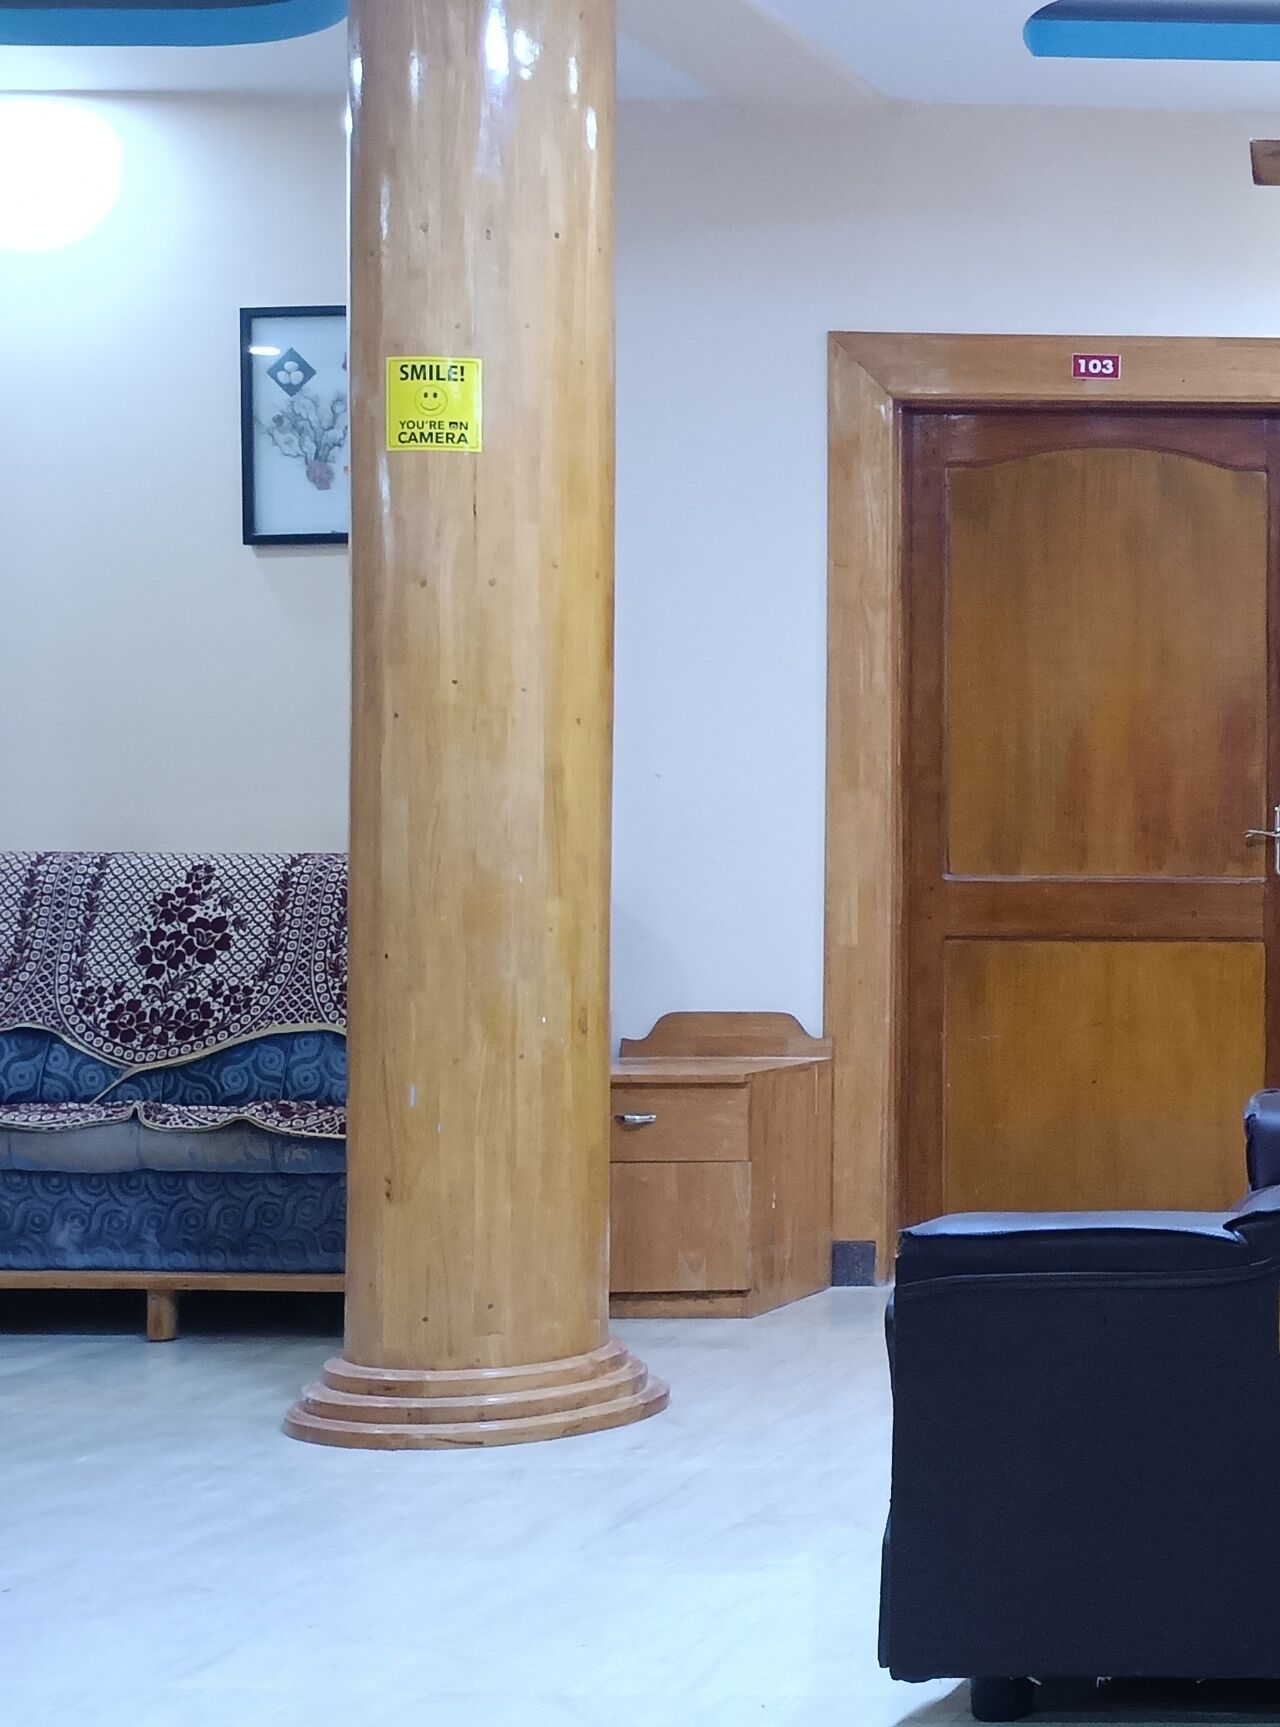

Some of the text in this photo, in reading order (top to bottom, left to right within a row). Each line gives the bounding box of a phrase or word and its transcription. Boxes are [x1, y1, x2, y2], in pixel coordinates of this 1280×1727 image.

[399, 364, 464, 382] SMILE!
[1078, 359, 1114, 374] 103
[399, 420, 445, 430] YOU'RE
[398, 431, 468, 444] CAMERA
